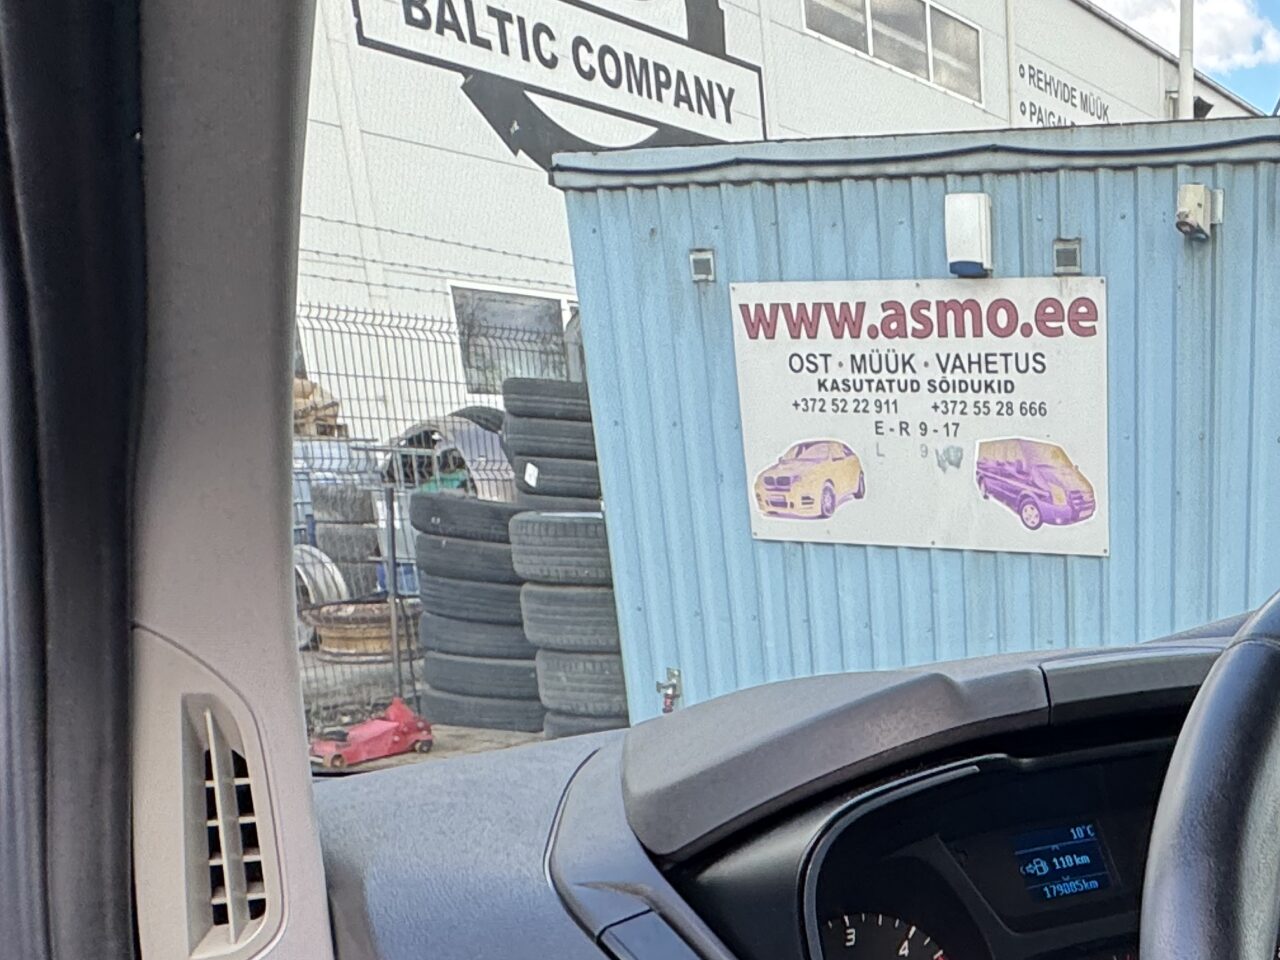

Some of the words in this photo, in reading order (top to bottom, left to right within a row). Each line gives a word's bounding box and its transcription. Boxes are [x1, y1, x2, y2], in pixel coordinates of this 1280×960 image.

[403, 0, 559, 69] BALTIC
[571, 36, 735, 125] COMPANY
[1028, 64, 1077, 108] REHVIDE
[739, 297, 1098, 339] www.asmo.ee
[788, 353, 832, 374] OST
[850, 349, 917, 374] MÜÜK
[935, 352, 1046, 374] VAHETUS
[817, 378, 921, 394] KASUTATUD
[927, 376, 1015, 395] SÕIDUKID
[792, 398, 827, 414] +372
[831, 398, 849, 414] 52
[853, 399, 870, 414] 22
[874, 399, 899, 414] 911
[931, 400, 967, 416] +372
[972, 401, 991, 416] 55
[996, 401, 1014, 416] 28
[1019, 402, 1047, 417] 666
[1070, 824, 1095, 840] 10°C
[844, 929, 856, 947] 3
[898, 940, 910, 957] 4
